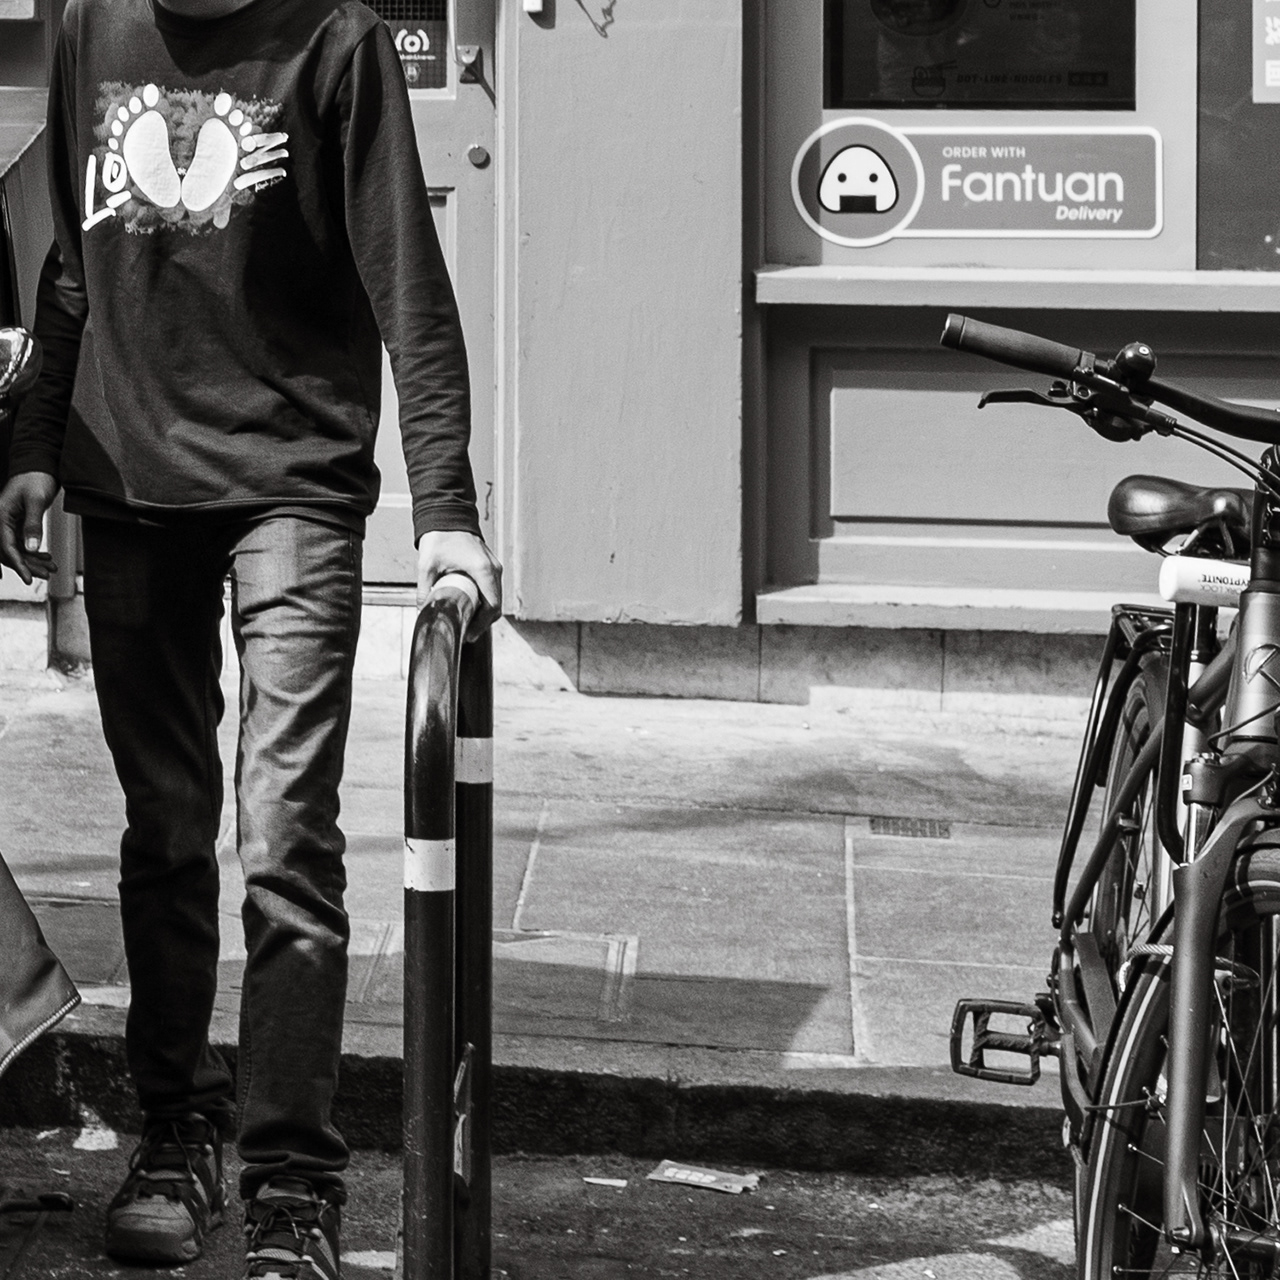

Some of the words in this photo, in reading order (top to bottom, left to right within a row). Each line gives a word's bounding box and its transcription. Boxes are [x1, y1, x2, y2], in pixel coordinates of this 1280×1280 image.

[941, 146, 988, 159] ORDER
[990, 146, 1026, 159] WITH
[941, 163, 1124, 203] Fantuan
[1054, 203, 1123, 223] Delivery
